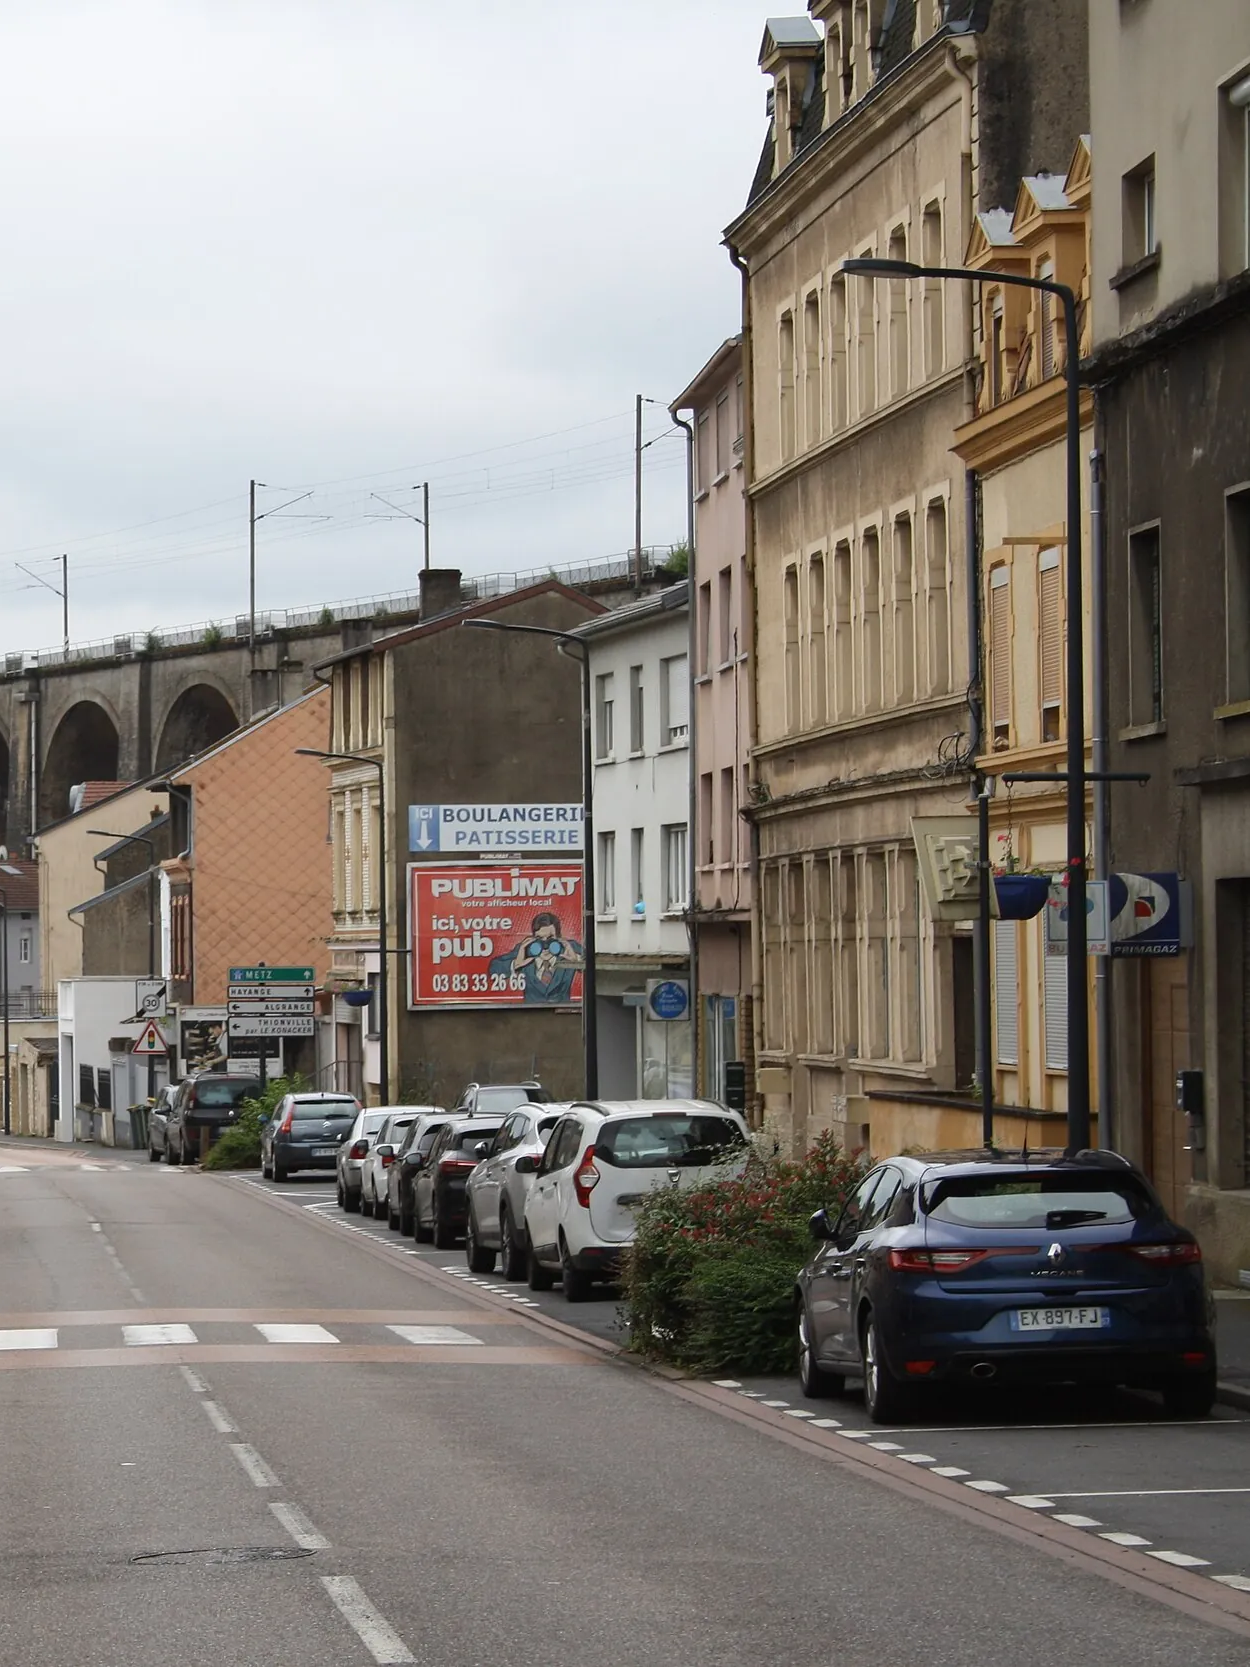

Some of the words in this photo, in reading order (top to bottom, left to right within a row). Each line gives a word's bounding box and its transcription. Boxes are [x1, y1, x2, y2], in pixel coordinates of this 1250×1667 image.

[415, 808, 433, 819] ICI
[442, 807, 584, 823] BOULANGERI
[455, 829, 579, 845] PATISSERIE
[487, 899, 527, 908] afficheur
[529, 898, 552, 907] local
[432, 915, 459, 934] ici,
[461, 916, 513, 931] votre
[432, 931, 494, 964] pub
[1048, 943, 1107, 953] BUAZ
[1114, 944, 1178, 954] PRIMAGAZ
[245, 970, 272, 979] METZ
[432, 974, 449, 992] 03
[452, 974, 469, 992] 83
[471, 974, 488, 991] 33
[491, 973, 506, 991] 26
[509, 973, 526, 991] 66
[230, 988, 272, 996] HAYANGE
[146, 999, 157, 1007] 30
[264, 1003, 312, 1011] ALGRANGE
[1020, 1308, 1098, 1326] EX-897-FJ
